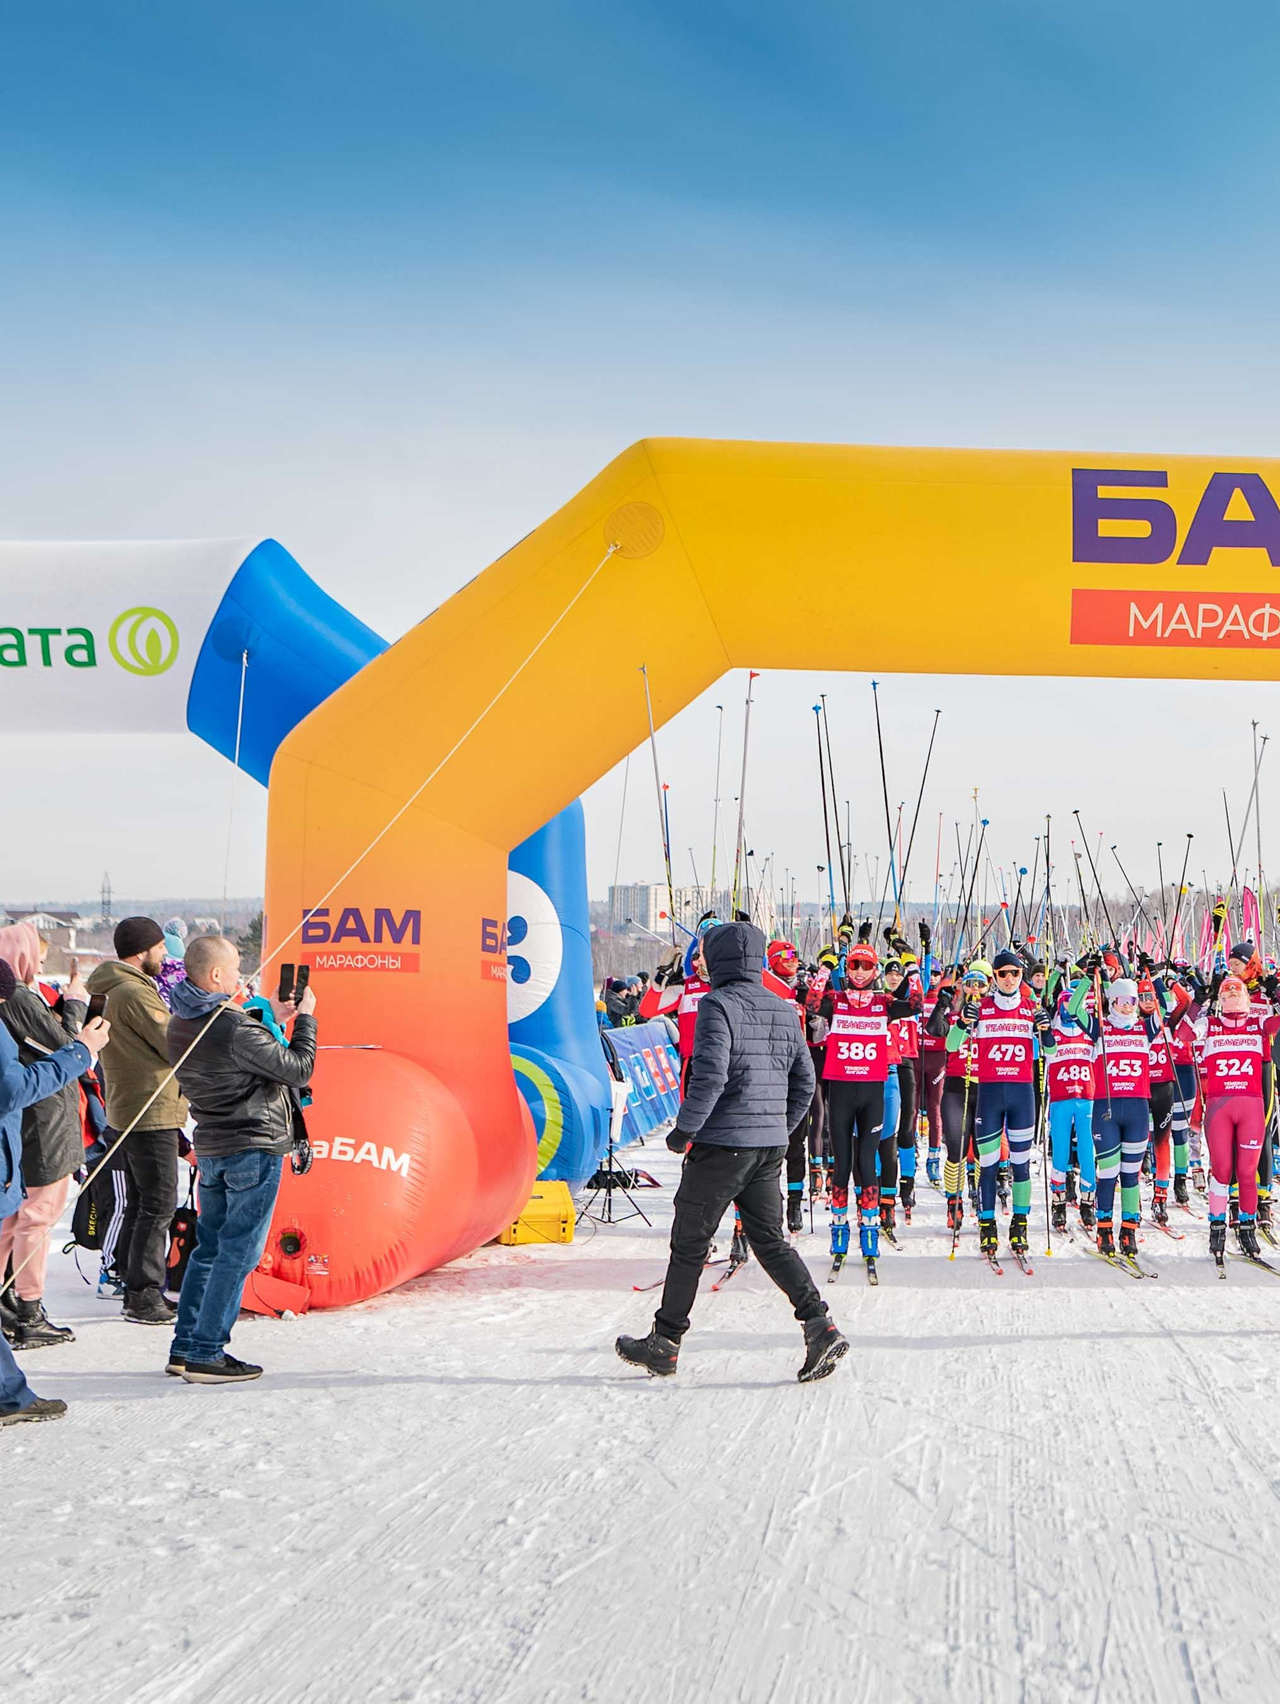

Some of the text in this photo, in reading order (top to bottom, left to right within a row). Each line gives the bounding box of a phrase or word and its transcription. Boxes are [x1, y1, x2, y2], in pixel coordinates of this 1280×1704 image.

[301, 908, 421, 945] БАМ
[315, 954, 401, 970] МАРАФОНЫ
[837, 1041, 877, 1060] 386
[988, 1044, 1025, 1061] 479
[1149, 1049, 1167, 1066] 96
[1056, 1065, 1091, 1081] 488
[1106, 1059, 1142, 1077] 453
[1215, 1059, 1253, 1077] 324
